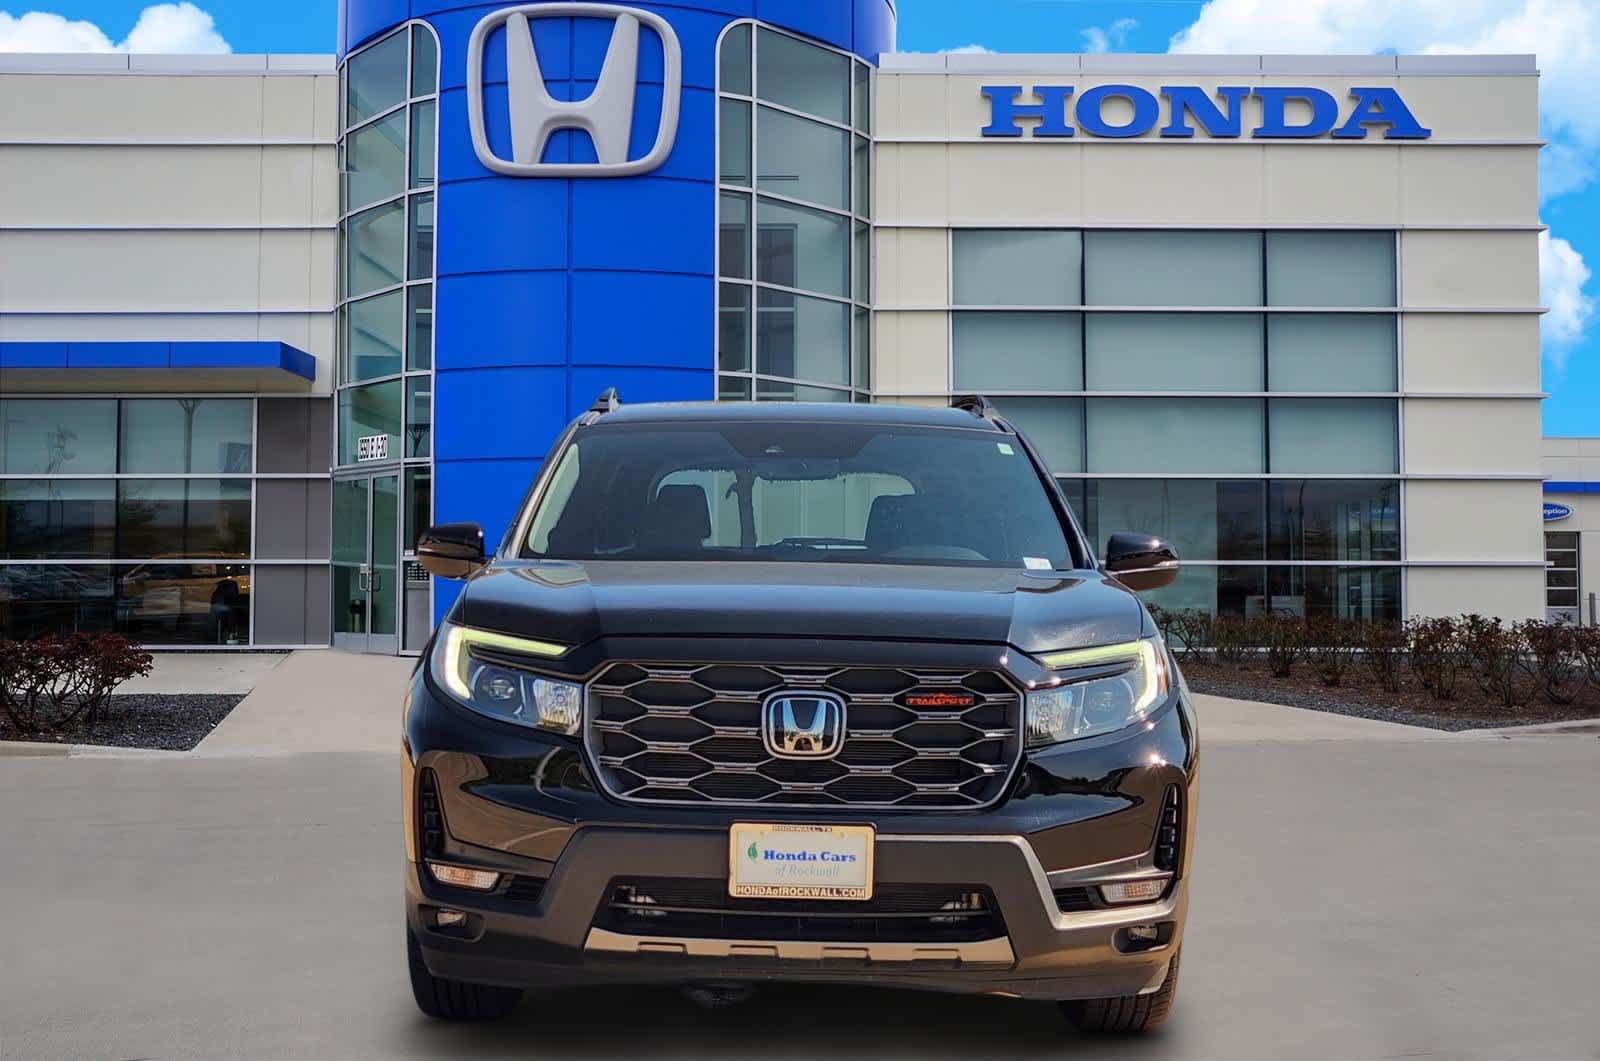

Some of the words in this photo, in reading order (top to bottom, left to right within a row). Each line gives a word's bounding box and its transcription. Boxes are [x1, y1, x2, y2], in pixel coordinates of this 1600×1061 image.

[981, 84, 1432, 139] HONDA
[763, 849, 818, 861] Honda
[820, 851, 857, 862] Cars
[775, 864, 787, 877] of
[789, 864, 840, 877] Rockwall
